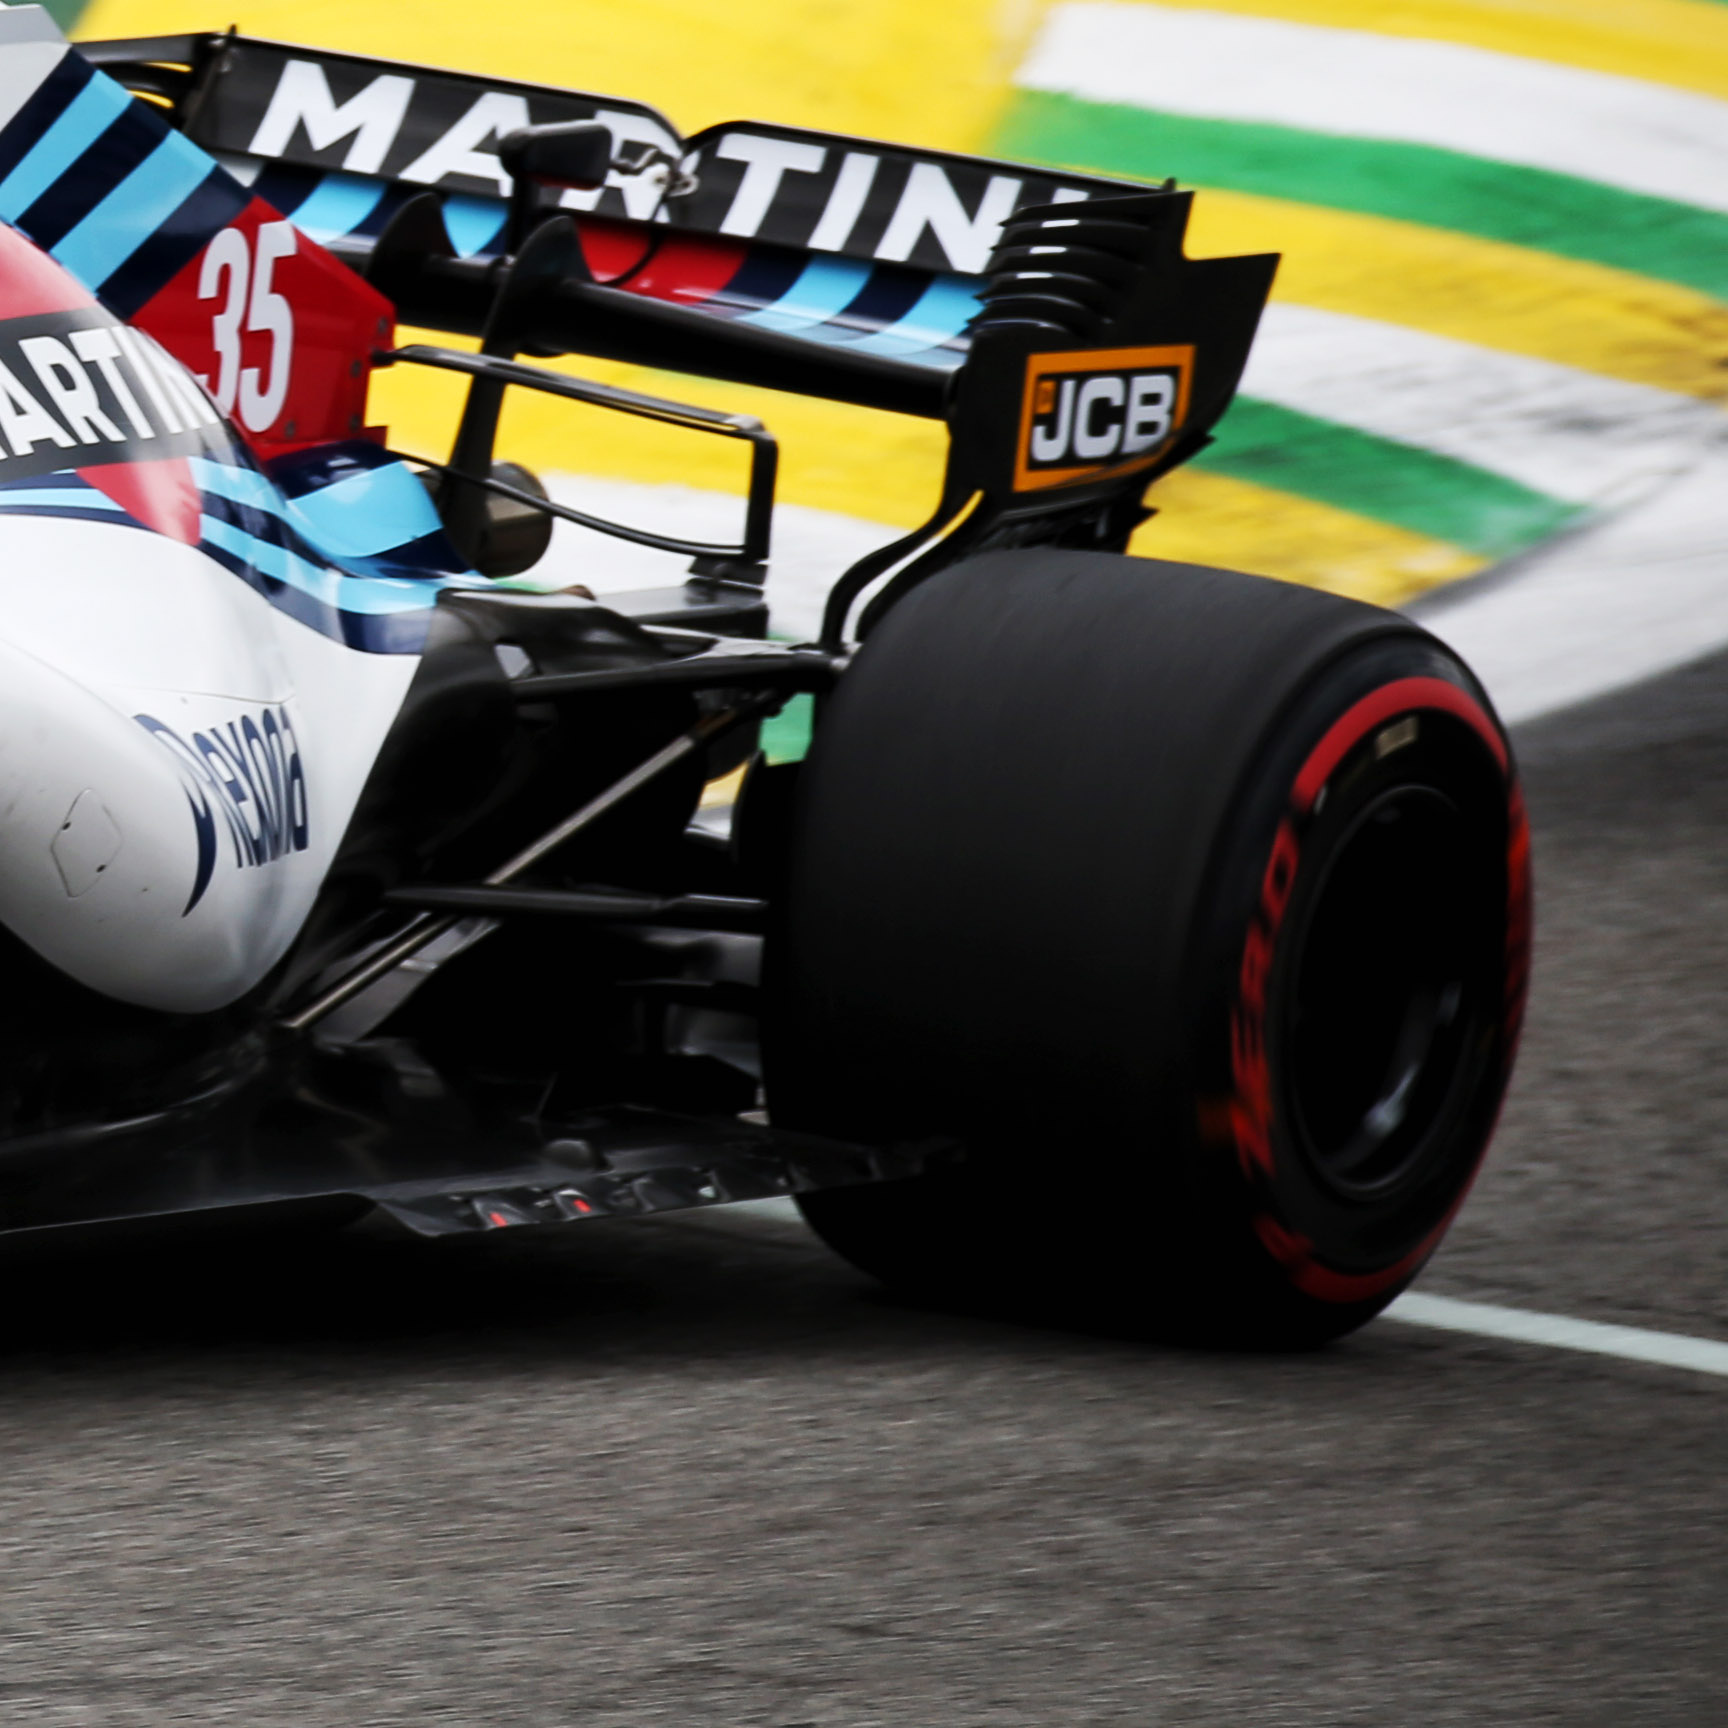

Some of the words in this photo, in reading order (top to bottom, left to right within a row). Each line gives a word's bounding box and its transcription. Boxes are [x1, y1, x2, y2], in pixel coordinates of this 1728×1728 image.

[248, 58, 1090, 274] MARTIN
[197, 219, 297, 432] 35
[1031, 374, 1175, 462] JCB
